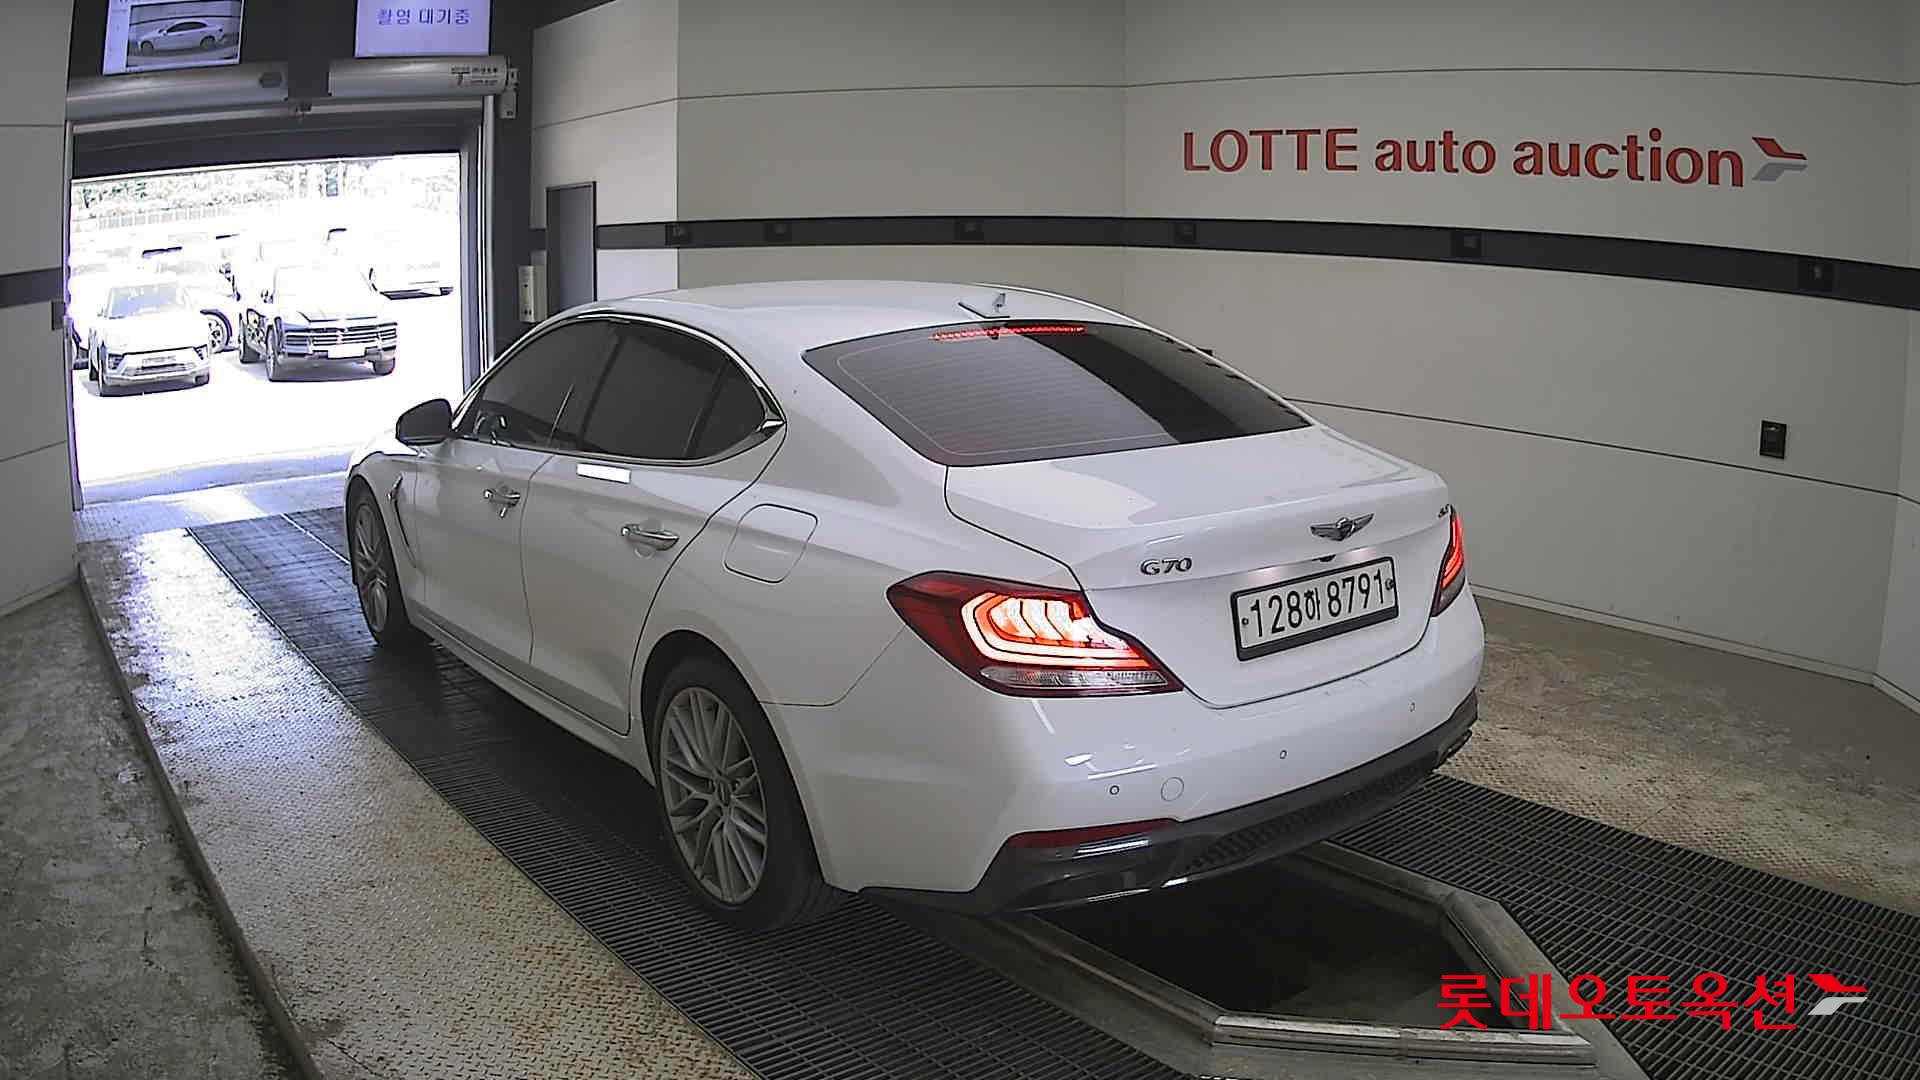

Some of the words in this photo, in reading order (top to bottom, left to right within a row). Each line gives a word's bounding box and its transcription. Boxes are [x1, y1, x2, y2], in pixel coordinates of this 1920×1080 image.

[1183, 128, 1358, 172] LOTTE
[1374, 130, 1497, 174] auto
[1513, 127, 1745, 187] auction
[1140, 557, 1193, 576] G70
